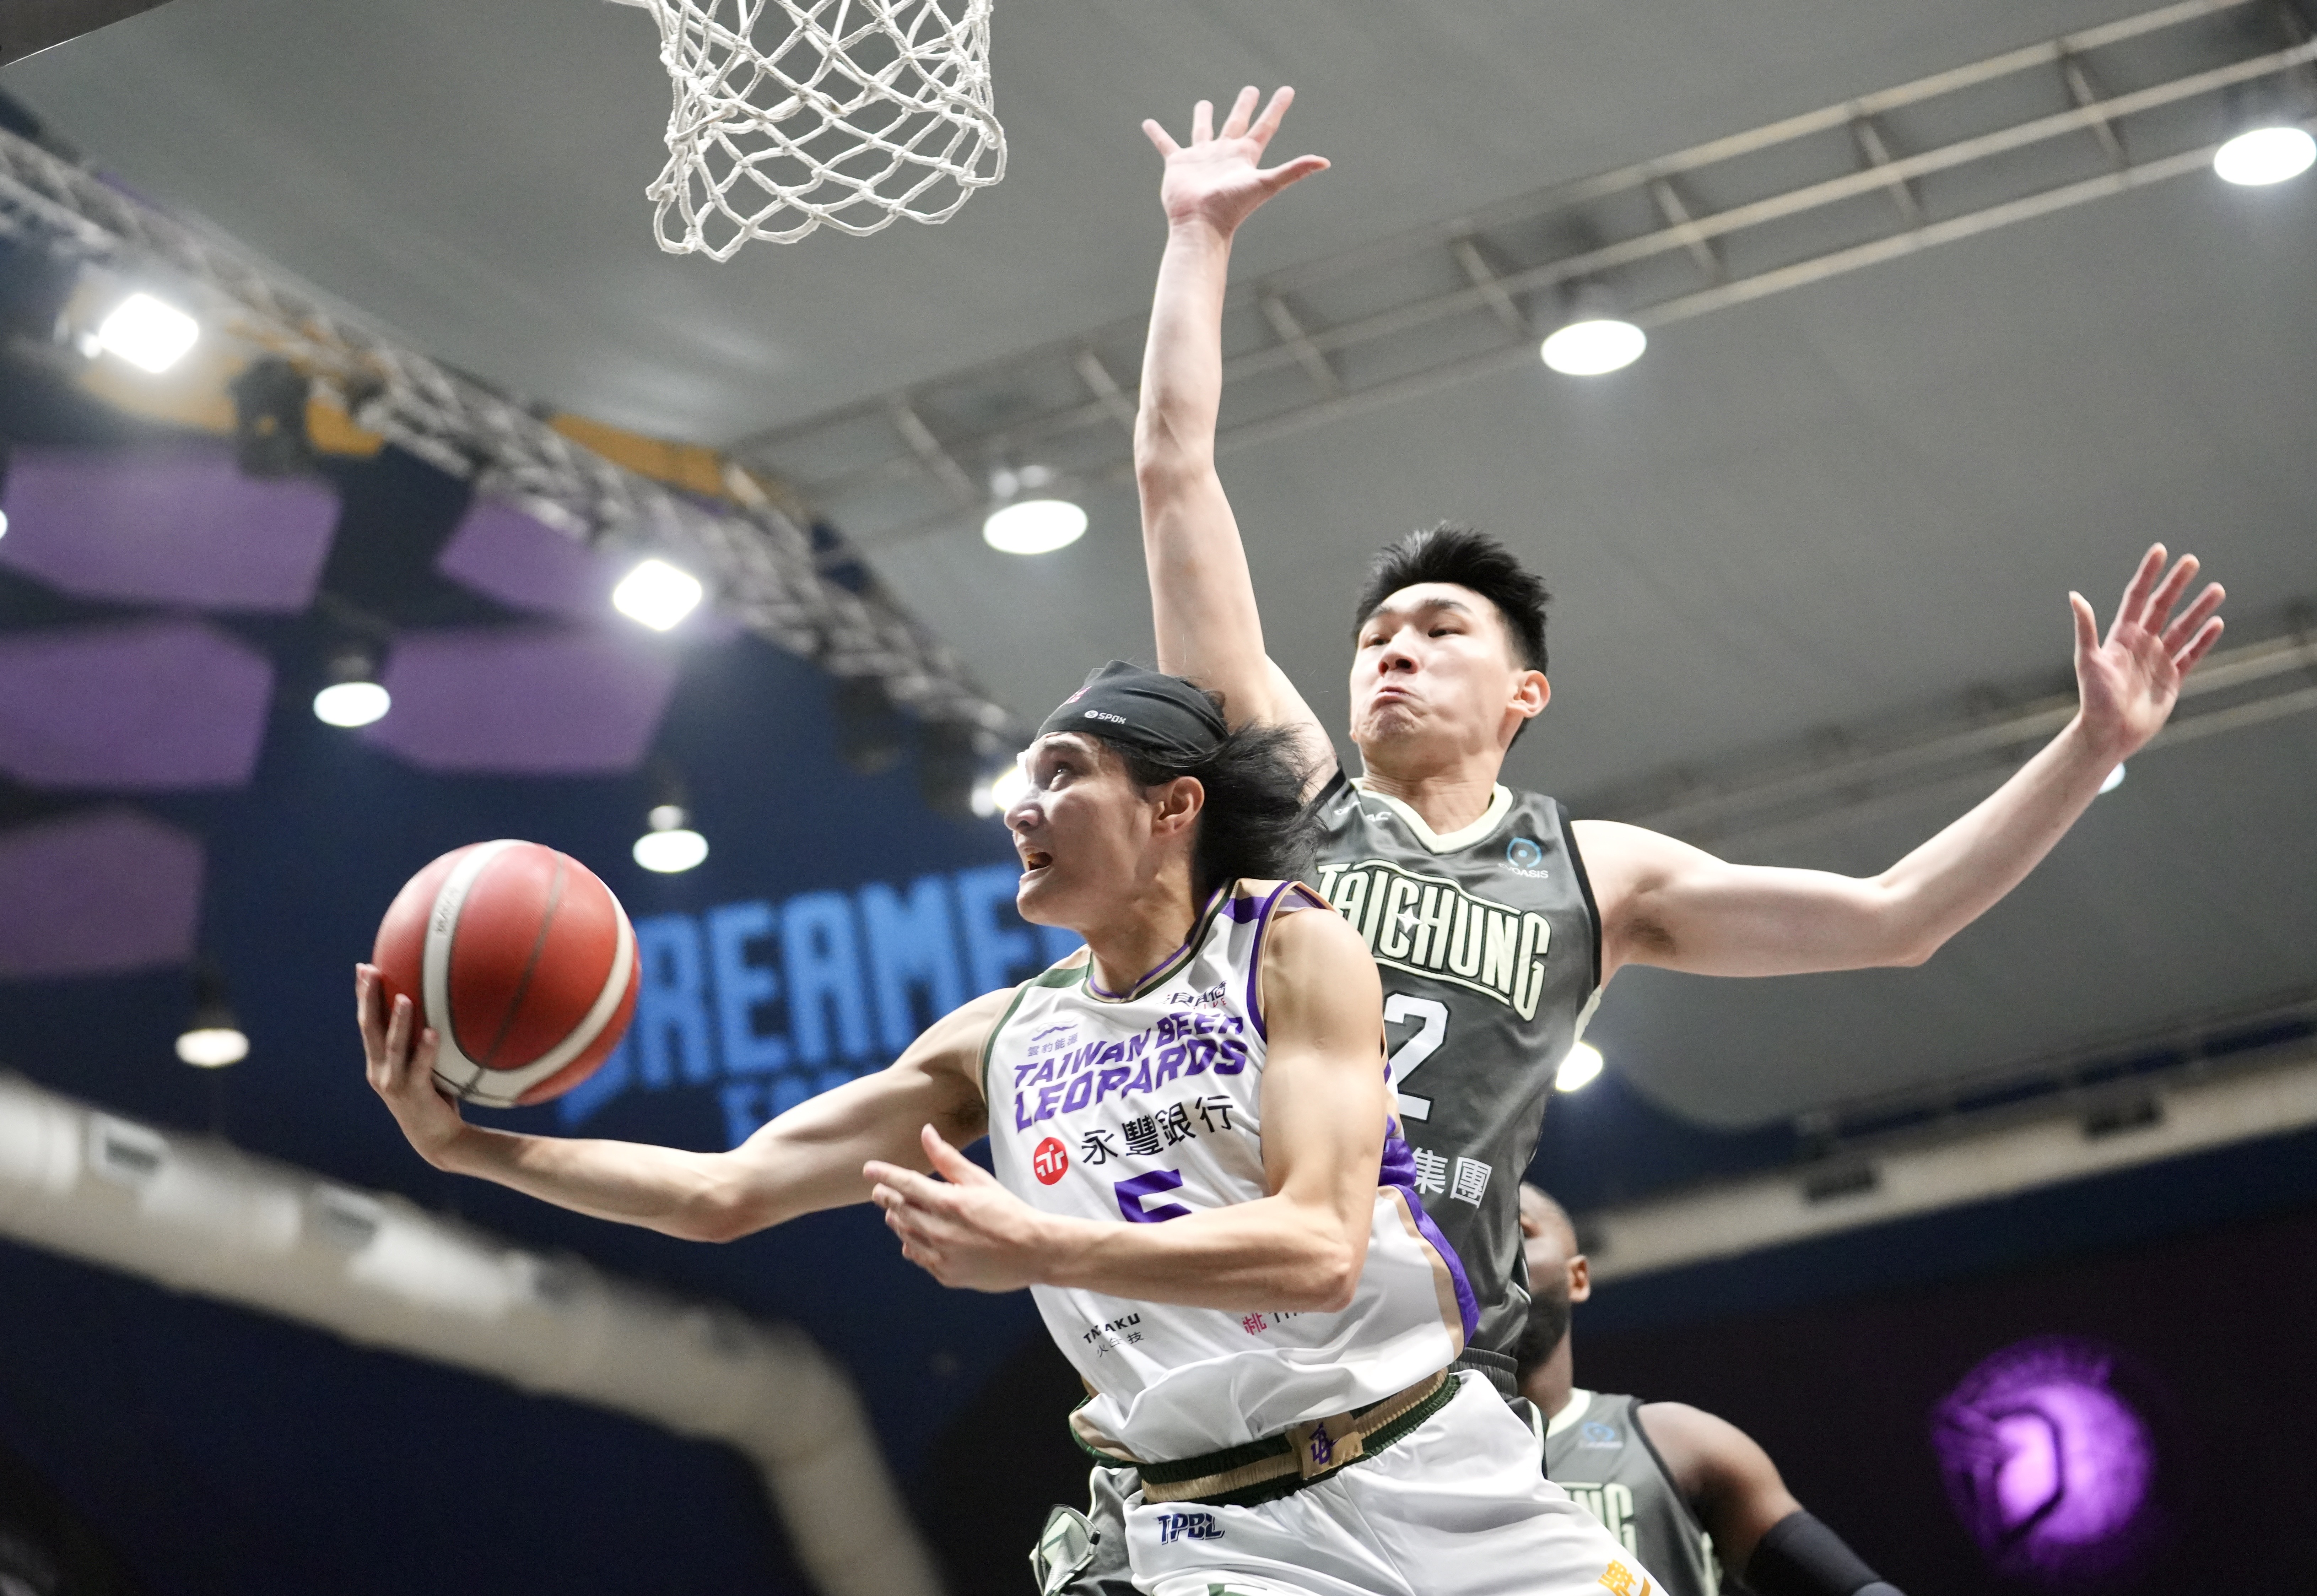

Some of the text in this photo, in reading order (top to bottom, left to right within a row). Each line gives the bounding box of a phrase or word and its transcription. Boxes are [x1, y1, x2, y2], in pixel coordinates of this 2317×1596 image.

[1097, 712, 1127, 724] SPOX
[1317, 862, 1552, 1022] TAICHUNG
[1193, 997, 1227, 1010] IVE
[1015, 1012, 1243, 1088] TAIWAN BEER
[1027, 1032, 1079, 1057] 雲豹能源
[1015, 1040, 1248, 1134] LEOPARDS
[1081, 1095, 1233, 1165] 永豐銀行
[1412, 1147, 1492, 1208] 集團
[1157, 1513, 1226, 1545] TPBL
